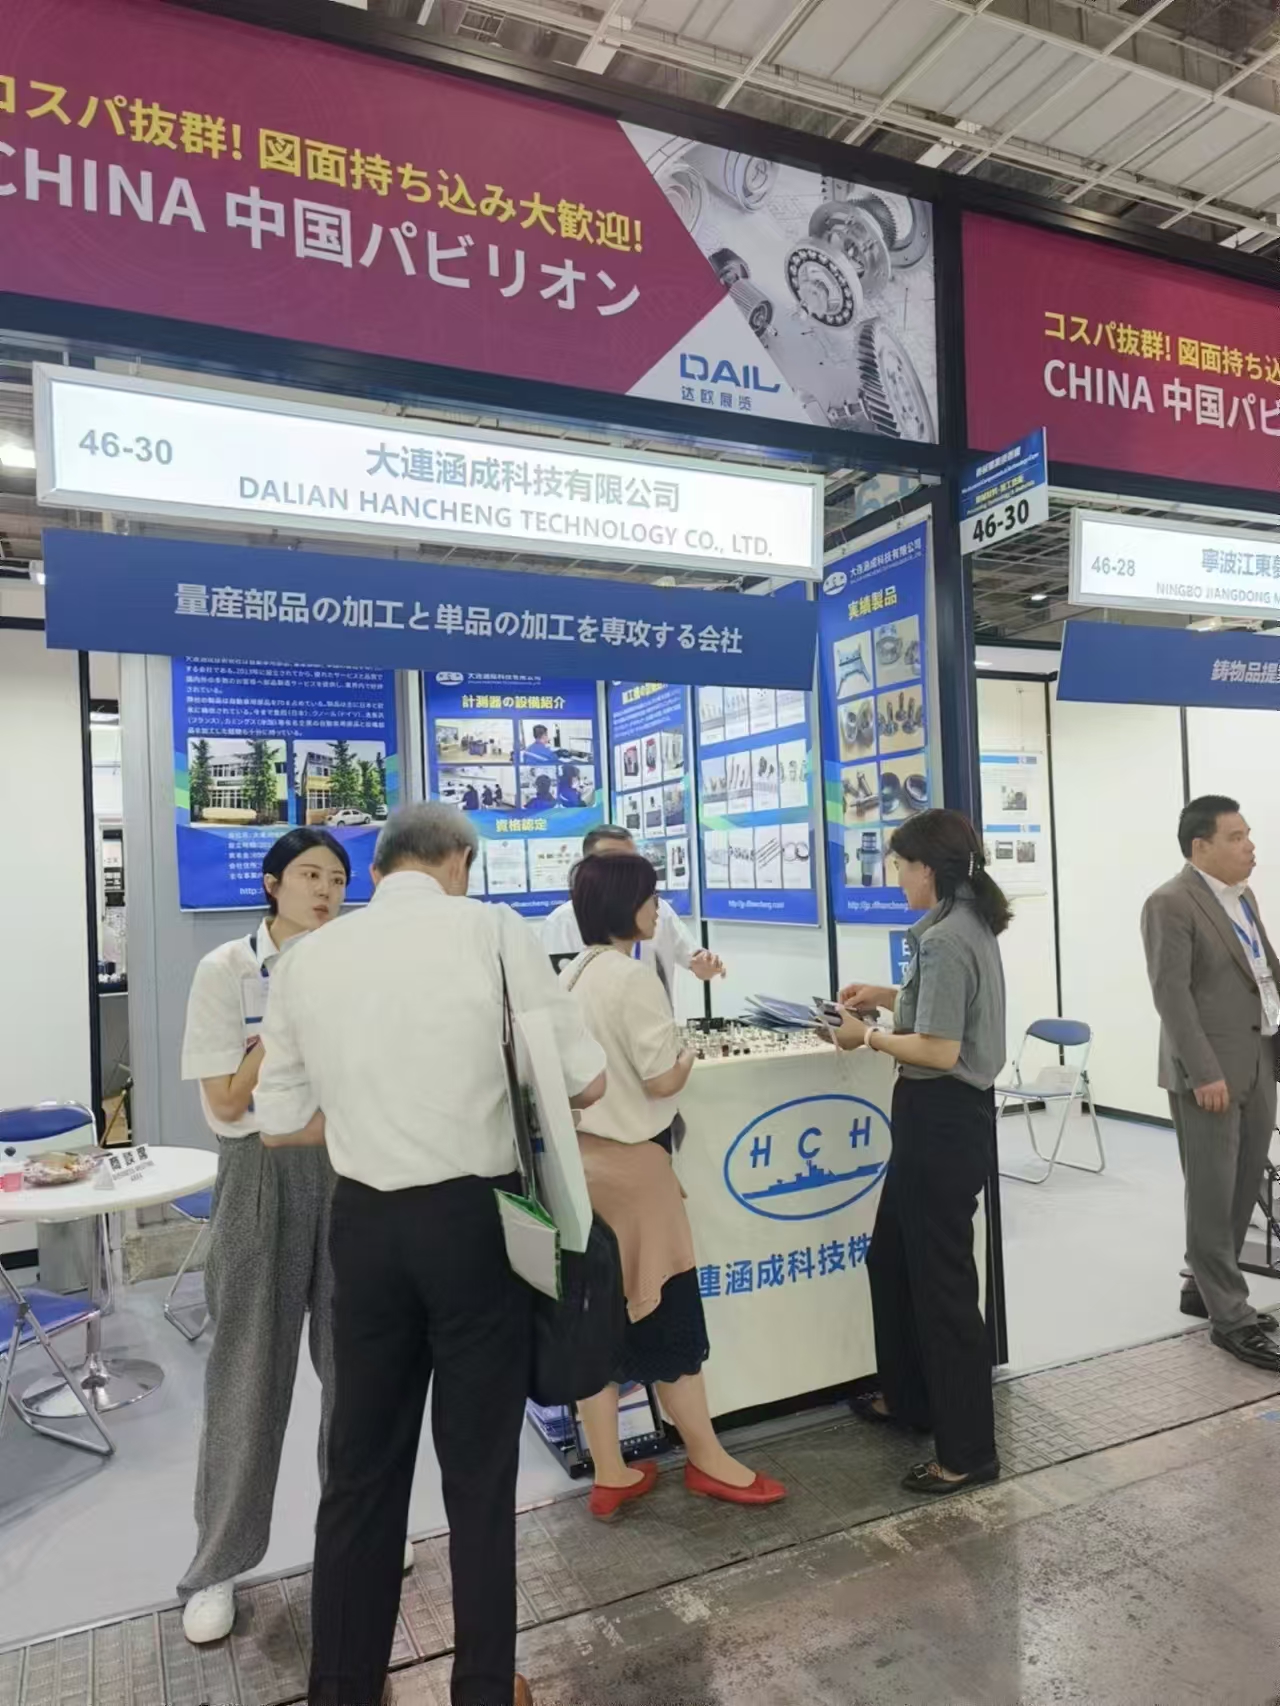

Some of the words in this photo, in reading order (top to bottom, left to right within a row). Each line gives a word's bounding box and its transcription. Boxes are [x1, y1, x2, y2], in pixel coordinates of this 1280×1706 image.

[259, 128, 643, 253] 図面持ち込み大歓迎!
[225, 185, 640, 316] 中国パビリオン
[1044, 311, 1171, 362] コスパ抜群!
[680, 352, 781, 394] DAIL
[681, 385, 752, 412] 达欧展览
[1044, 359, 1155, 413] CHINA
[79, 428, 173, 465] 46-30
[366, 442, 679, 513] 大連涵成科技有限公司
[239, 476, 348, 510] DALIAN
[359, 490, 511, 528] HANCHENG
[520, 509, 677, 547] TECHNOLOGY
[685, 530, 725, 555] CO.,
[732, 535, 773, 558] LTD.
[973, 498, 1029, 542] 46-30
[1091, 555, 1136, 577] 46-28
[174, 582, 743, 654] 量産部品の加工と単品の加工を専攻する会社
[1156, 581, 1202, 599] NINGBO
[1206, 587, 1271, 605] JIANGDONG
